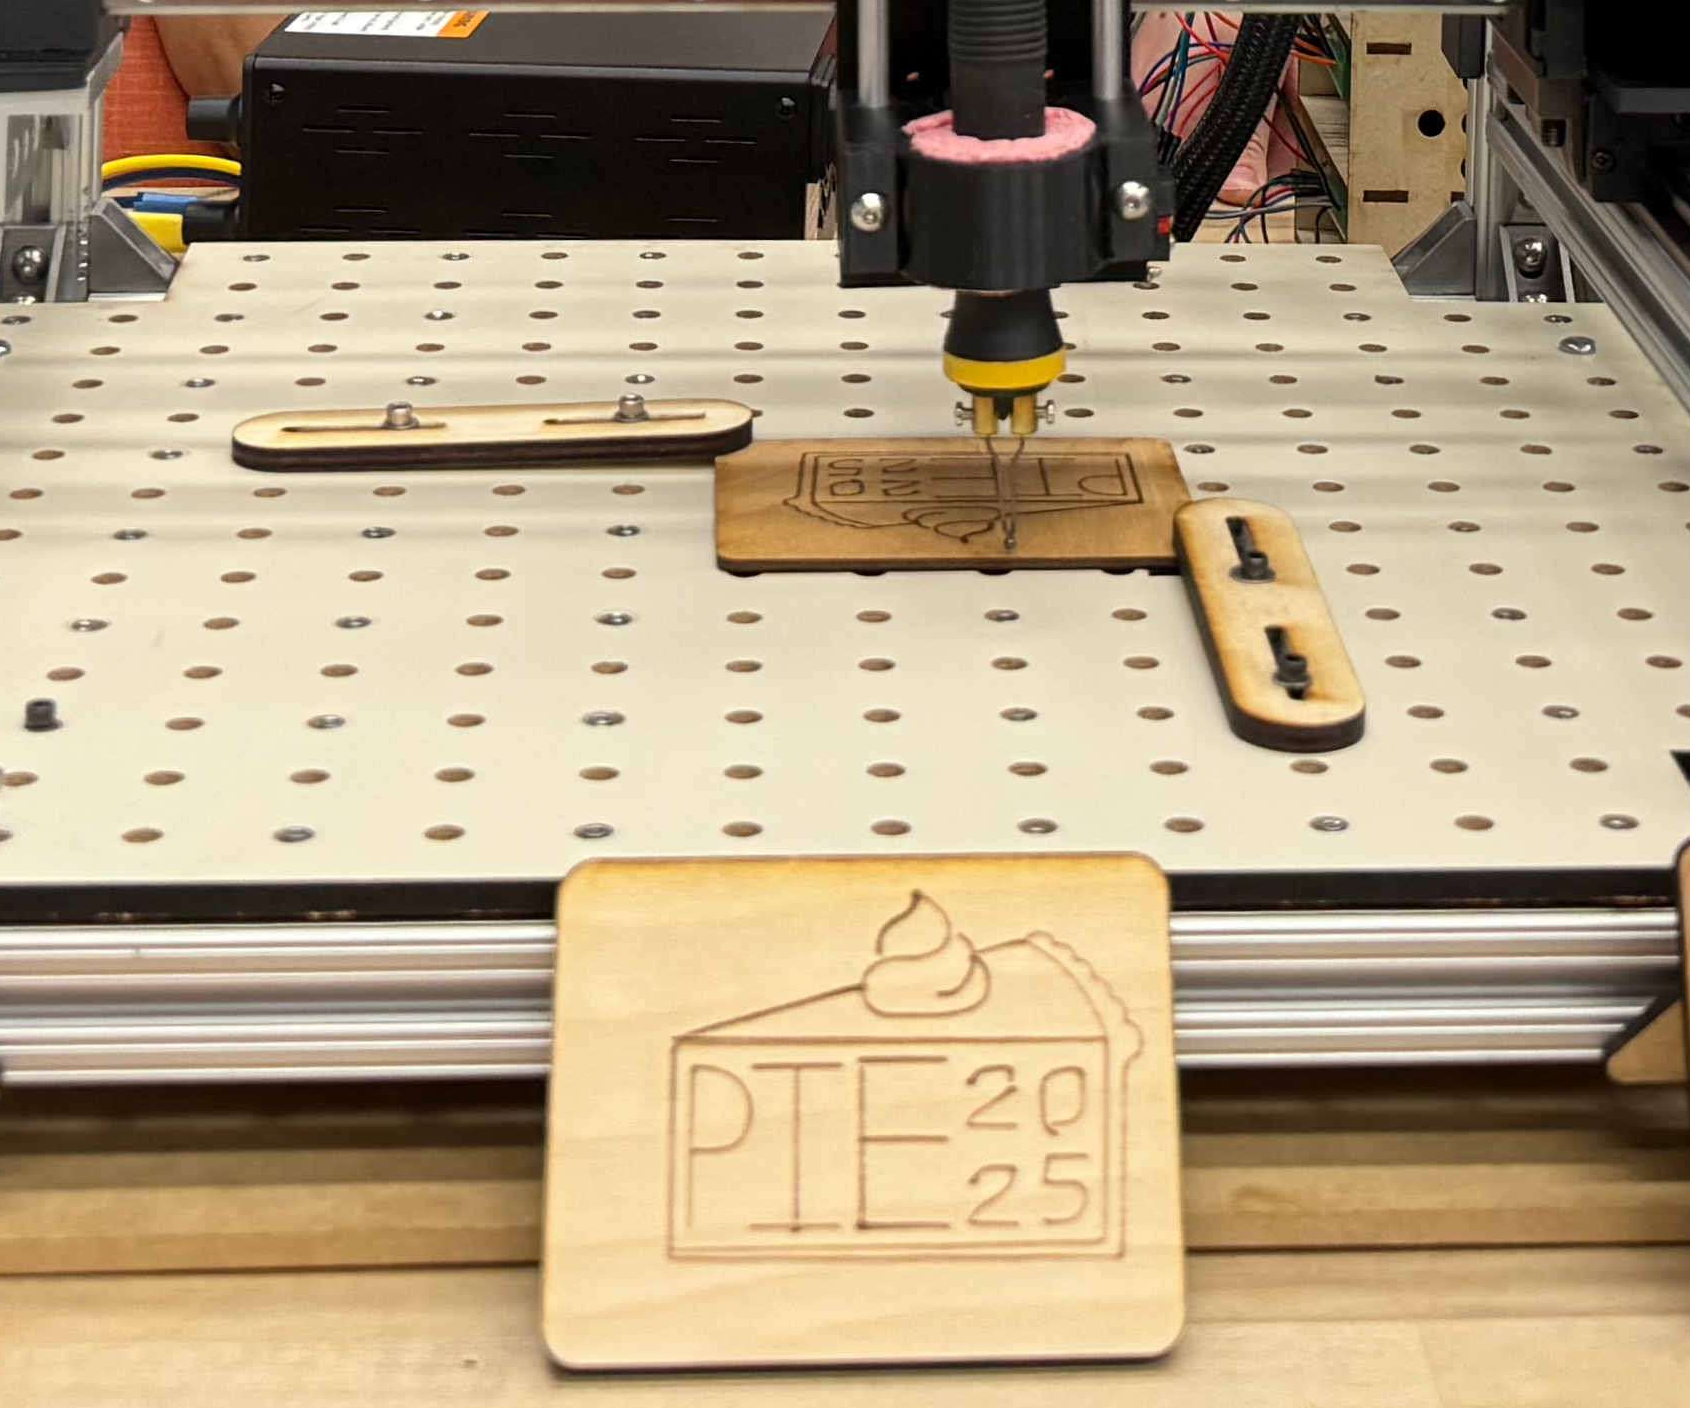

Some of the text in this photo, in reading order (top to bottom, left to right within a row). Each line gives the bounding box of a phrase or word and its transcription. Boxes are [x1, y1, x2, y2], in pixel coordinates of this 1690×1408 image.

[685, 1054, 1088, 1233] PIE 20
[965, 1151, 1090, 1229] 25
